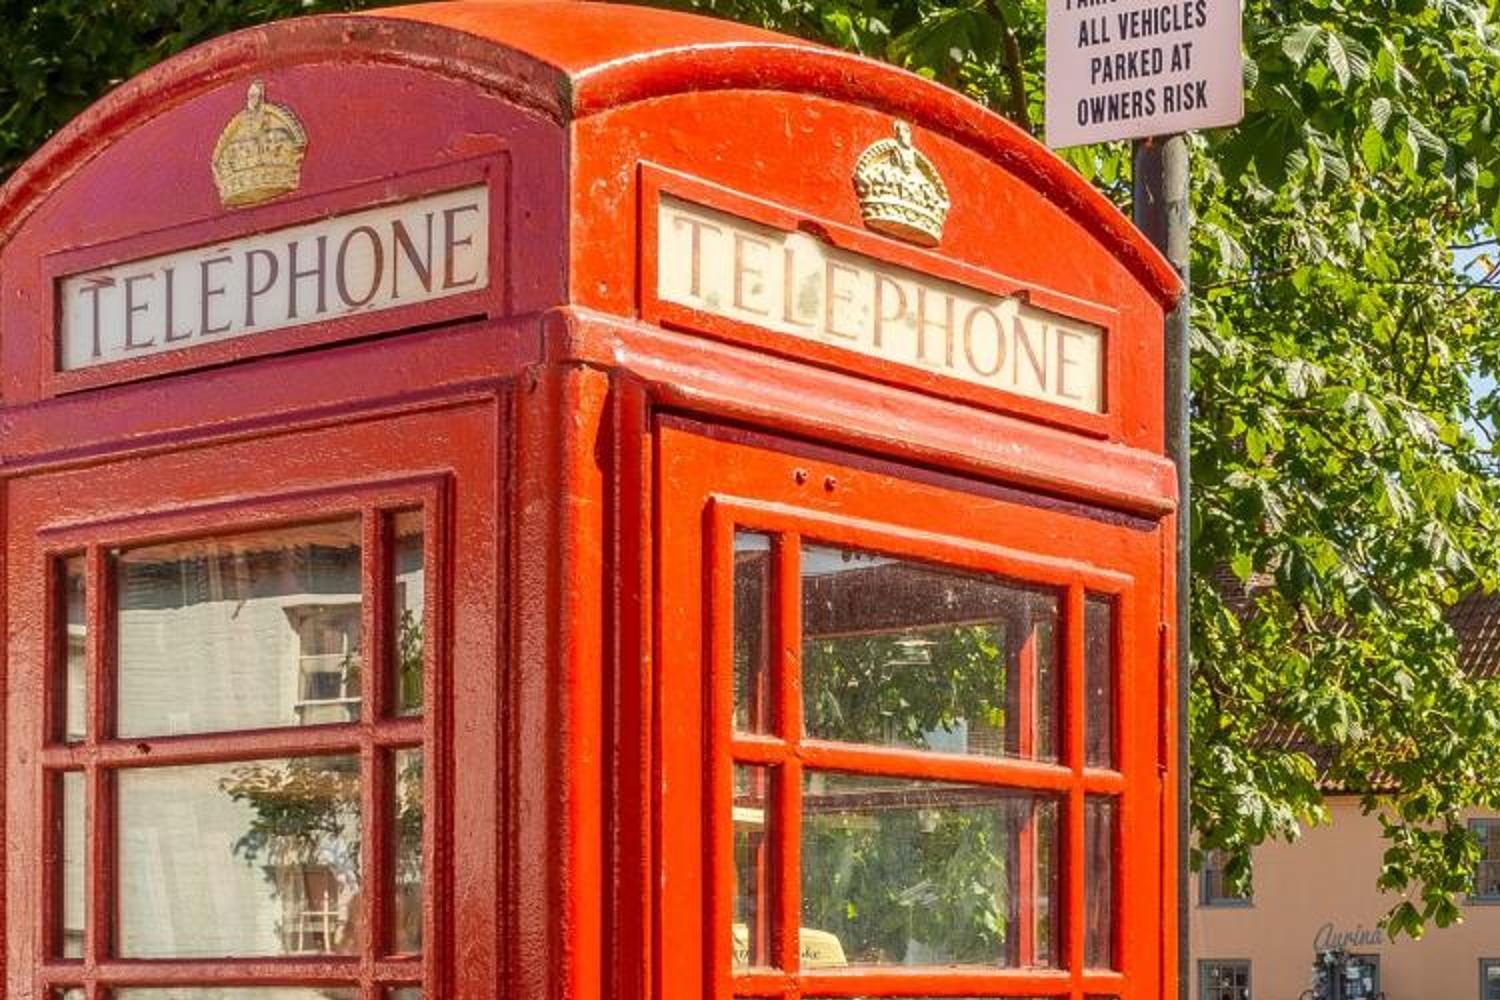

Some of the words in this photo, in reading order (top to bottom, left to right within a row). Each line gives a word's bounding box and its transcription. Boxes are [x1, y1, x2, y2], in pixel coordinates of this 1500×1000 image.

[1077, 16, 1111, 48] ALL
[1118, 2, 1207, 41] VEHICLES
[1091, 48, 1163, 85] PARKED
[1171, 43, 1193, 72] AT
[1077, 89, 1156, 126] OWNERS
[1163, 80, 1208, 114] RISK
[79, 203, 480, 358] TELEPHONE
[671, 215, 1083, 400] TELEPHONE
